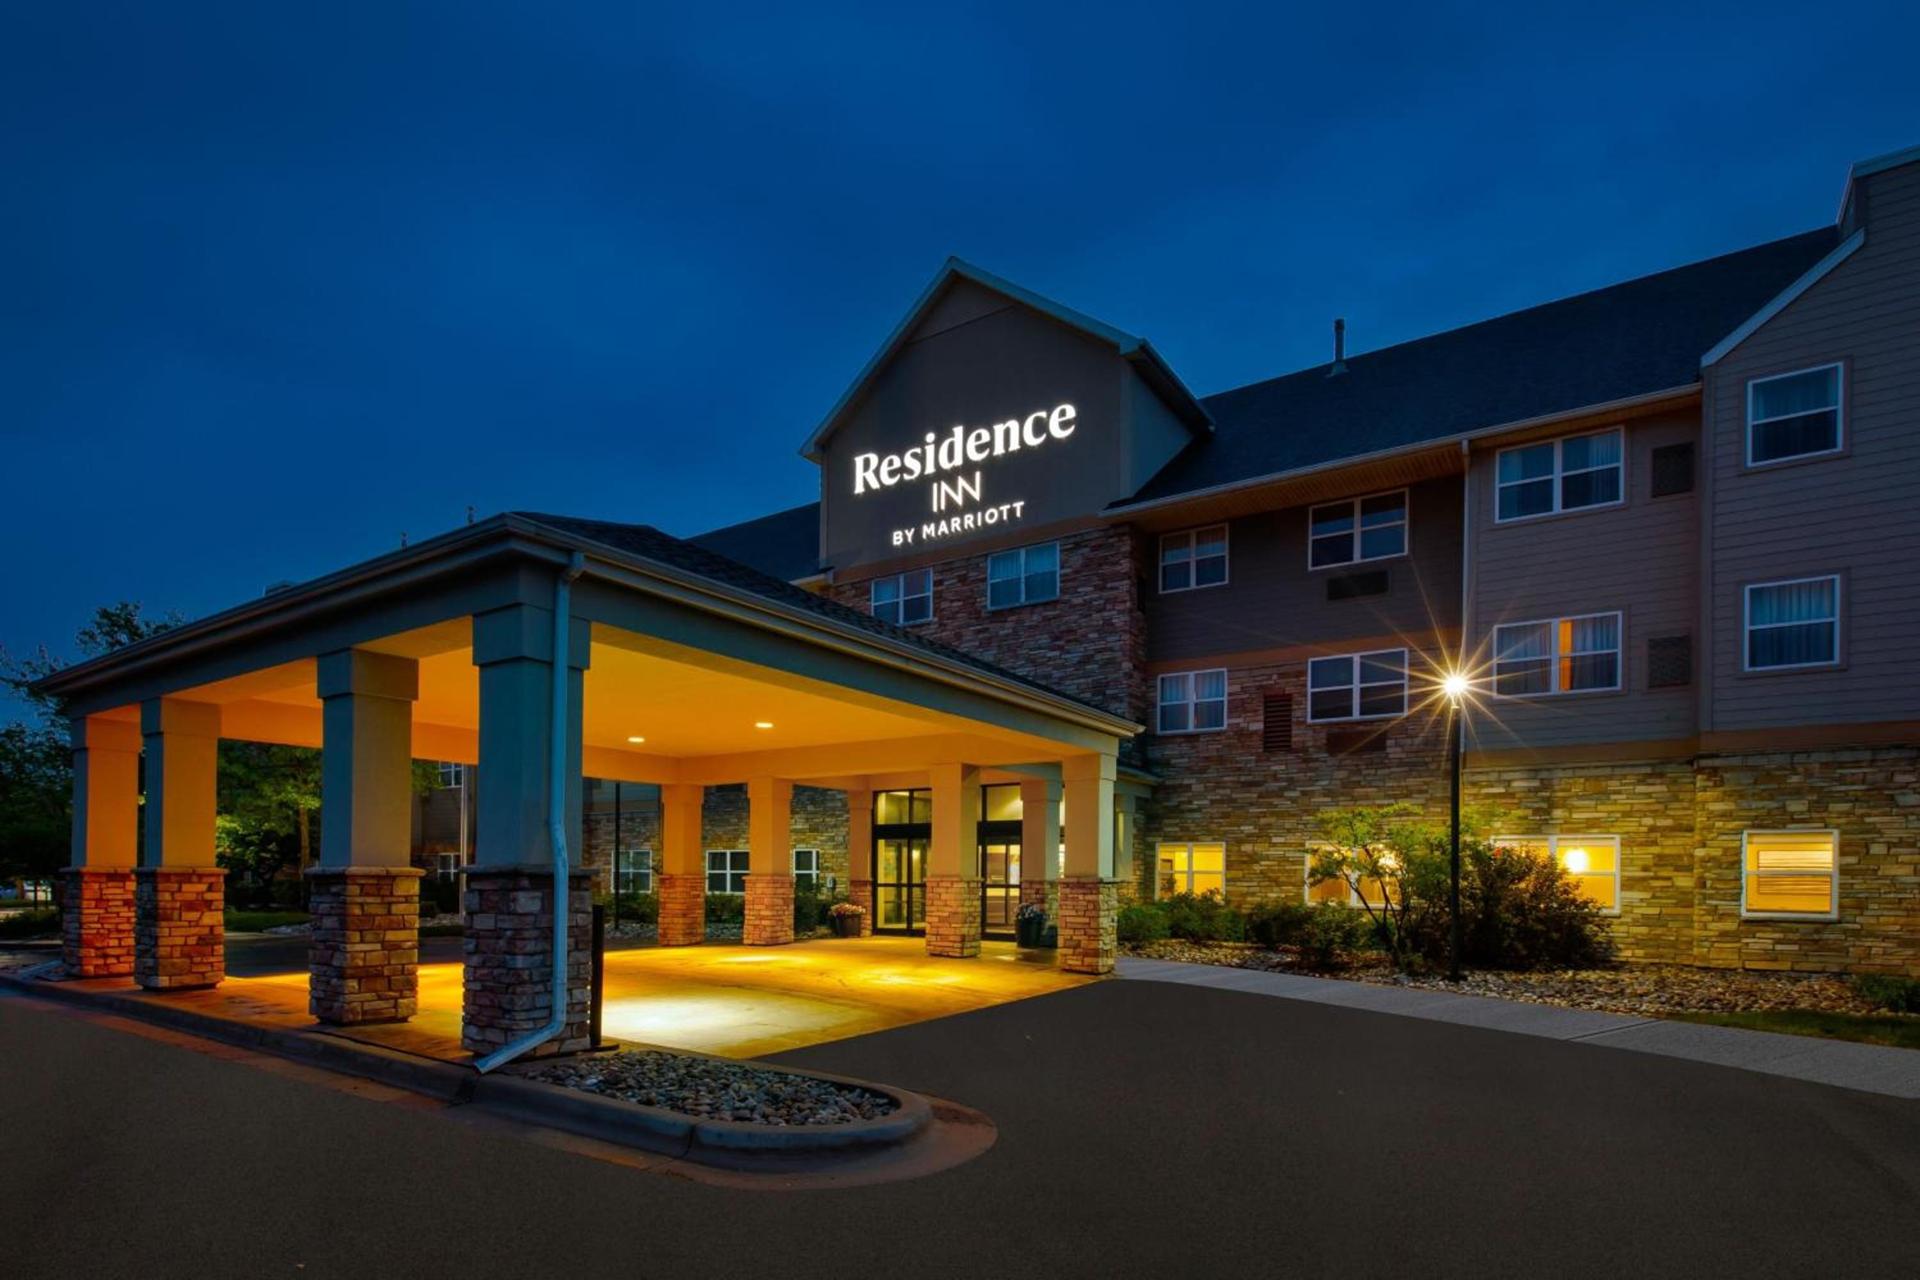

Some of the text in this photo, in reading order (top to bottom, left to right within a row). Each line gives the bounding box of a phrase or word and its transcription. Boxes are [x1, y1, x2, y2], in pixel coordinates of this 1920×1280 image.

[853, 402, 1077, 495] Residence
[932, 470, 982, 513] INN
[892, 500, 1025, 547] BY MARRIOTT
